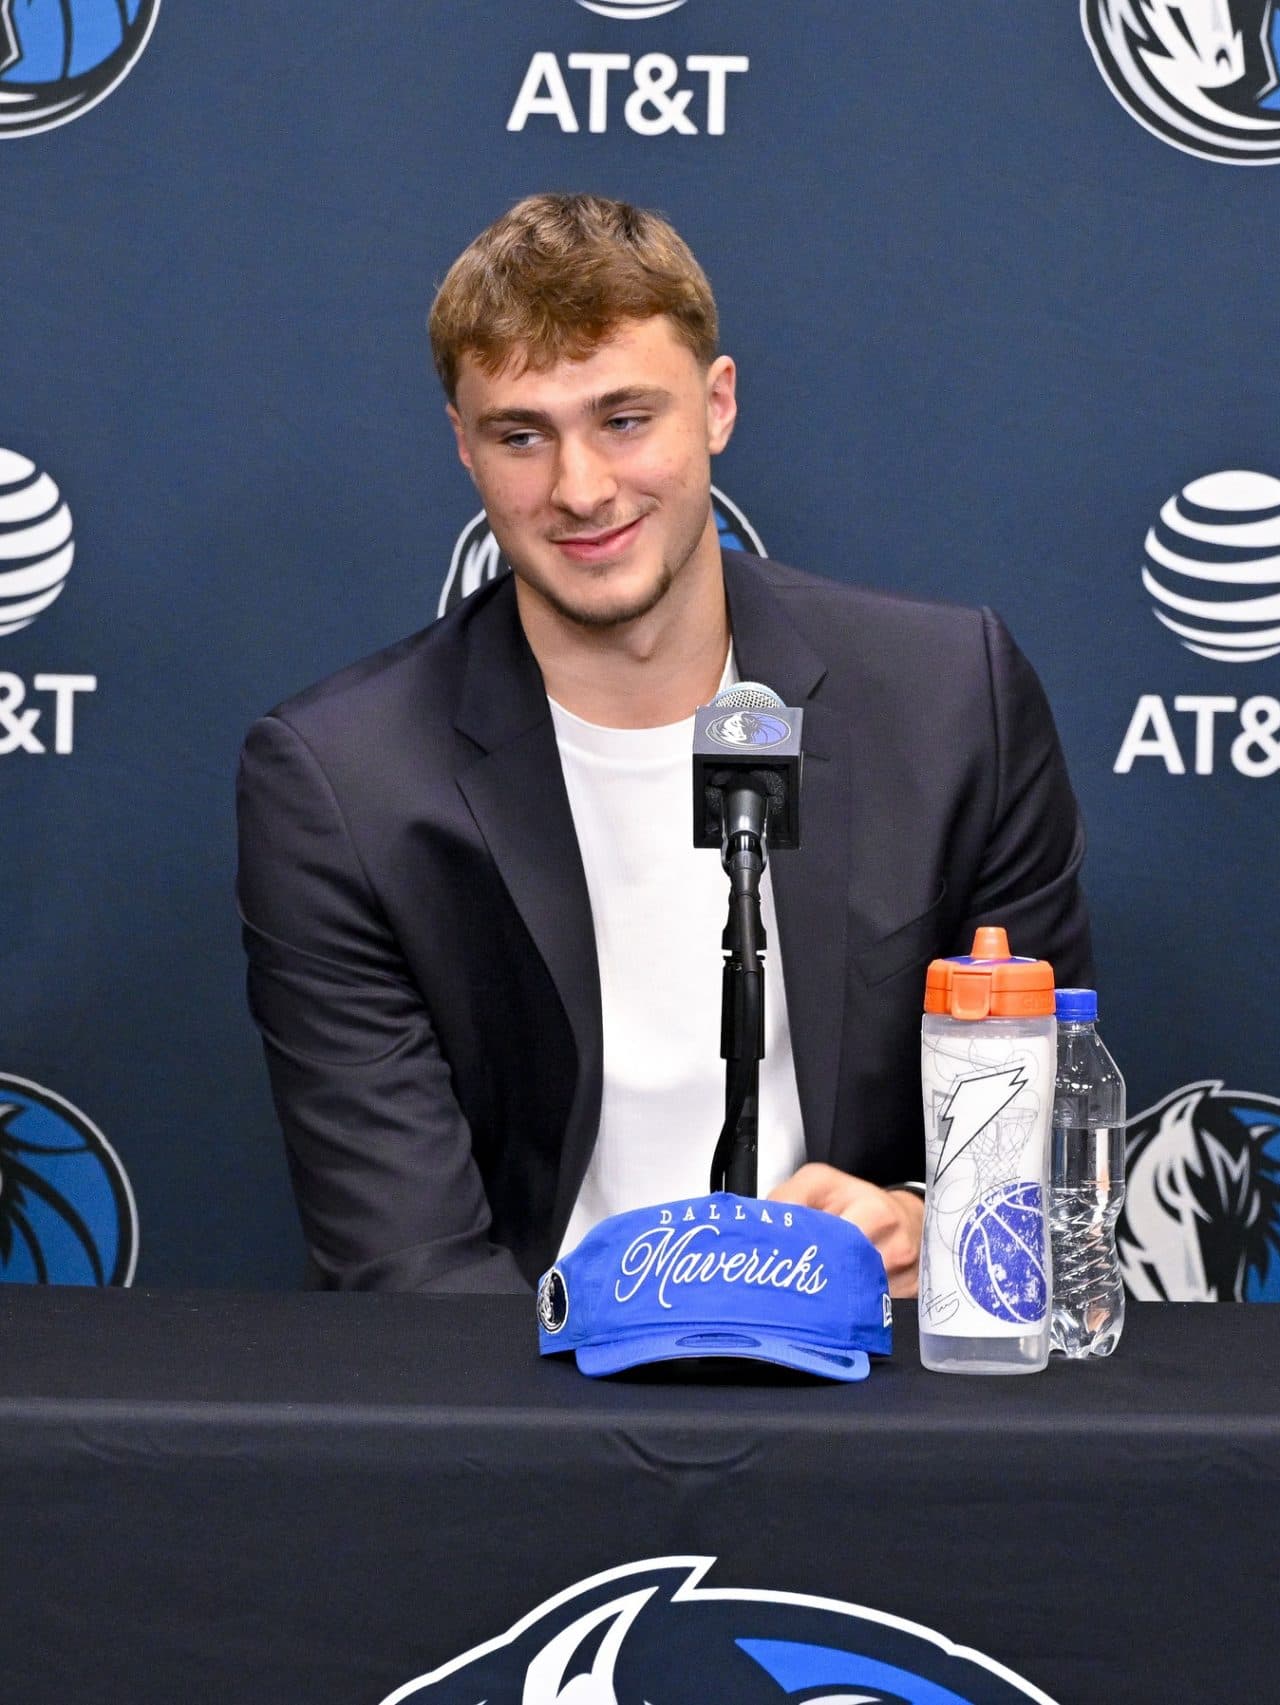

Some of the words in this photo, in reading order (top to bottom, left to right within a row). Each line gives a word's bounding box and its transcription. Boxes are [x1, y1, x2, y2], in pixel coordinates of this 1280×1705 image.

[507, 52, 749, 136] AT&T
[660, 1204, 793, 1228] DALLAS
[614, 1224, 828, 1309] Mavericks
